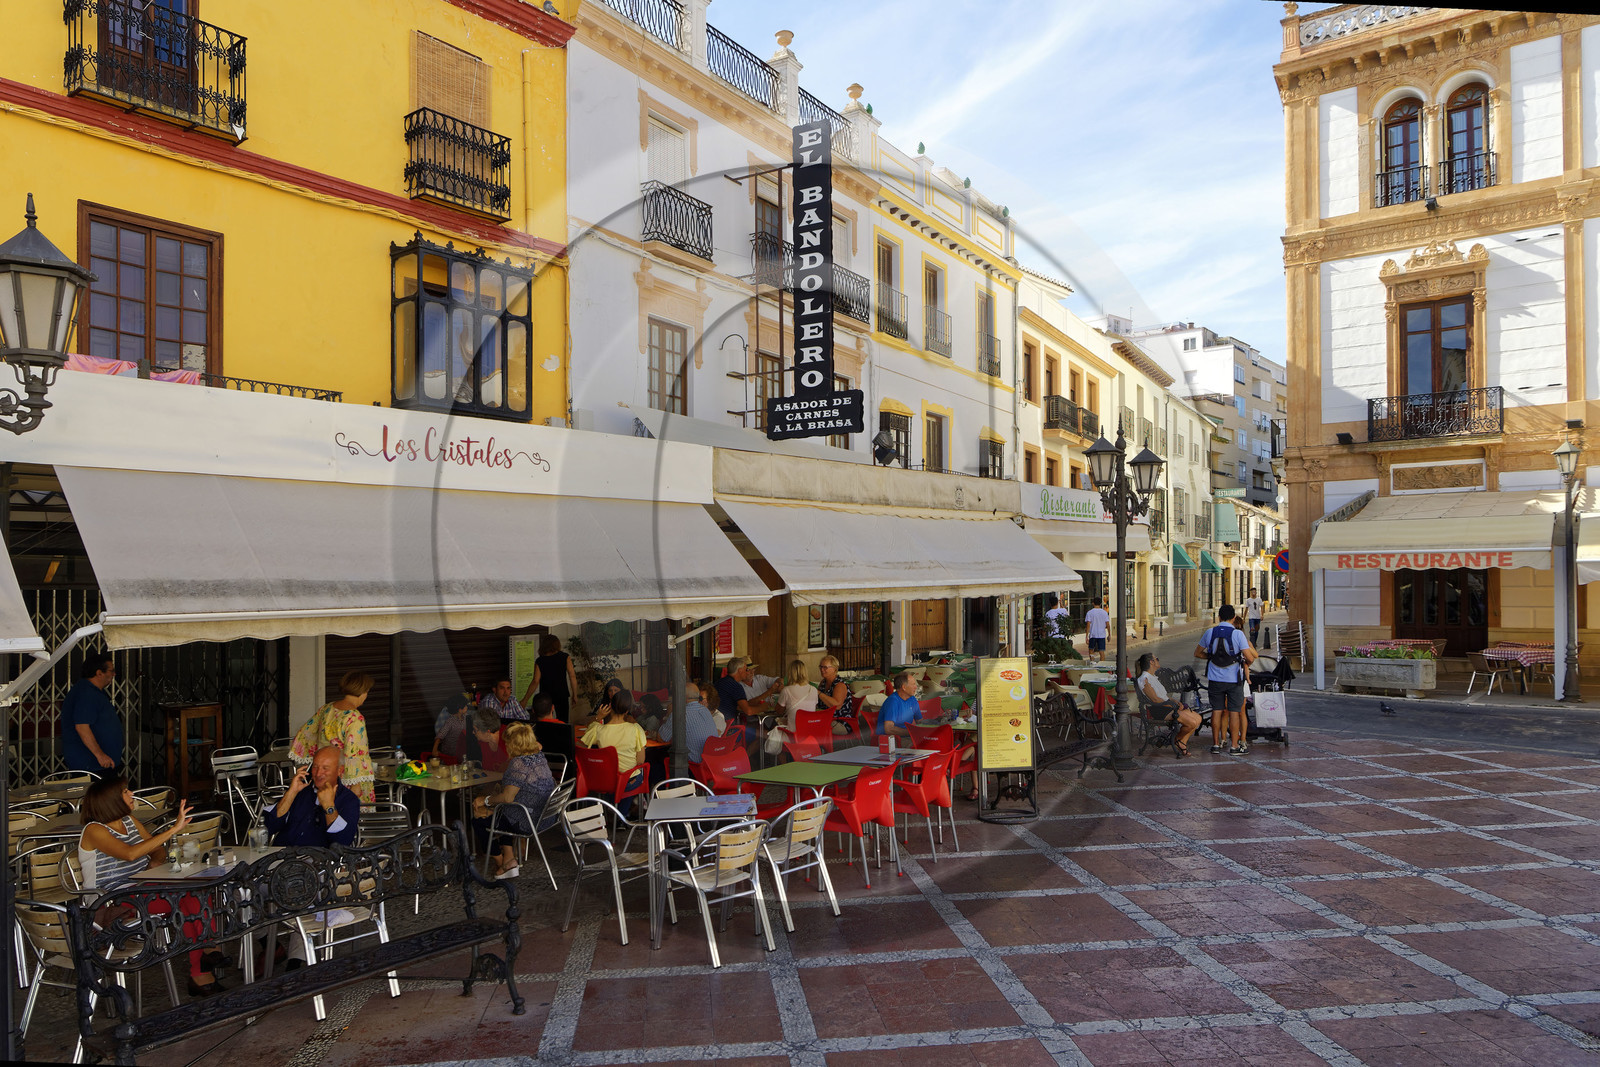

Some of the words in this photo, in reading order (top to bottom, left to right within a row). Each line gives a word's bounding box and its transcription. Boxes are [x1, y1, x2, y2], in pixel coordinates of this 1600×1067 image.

[799, 128, 822, 168] EL
[799, 185, 824, 388] BANDOLERO
[774, 399, 828, 412] ASADOR
[832, 396, 852, 406] DE
[785, 408, 840, 421] CARNES
[773, 424, 782, 433] A
[786, 422, 803, 432] LA
[807, 418, 853, 430] BRASA
[382, 424, 420, 462] Los
[424, 426, 513, 469] Cristales
[1040, 488, 1097, 517] Ristorante
[1338, 551, 1513, 569] RESTAURANTE
